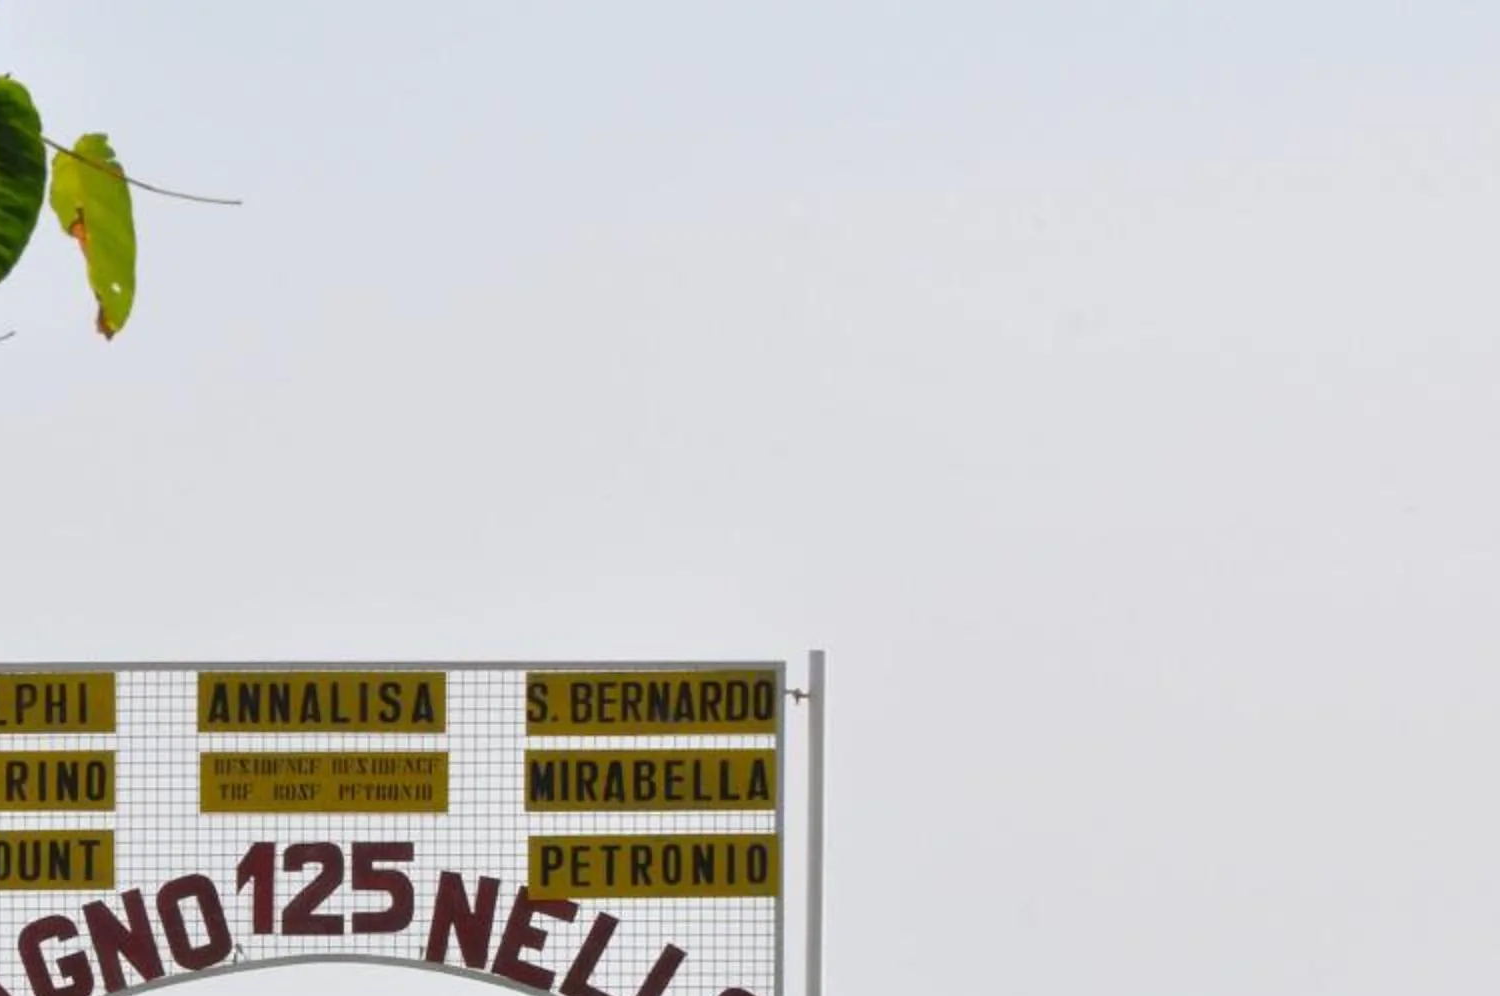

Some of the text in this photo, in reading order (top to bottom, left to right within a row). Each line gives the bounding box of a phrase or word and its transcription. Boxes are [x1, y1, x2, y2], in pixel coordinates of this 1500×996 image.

[208, 681, 435, 724] ANNALISA
[527, 679, 775, 724] S. BERNARDO
[214, 757, 440, 776] RESIDENCE RESIDENCE
[530, 758, 770, 802] MIRABELLA
[339, 782, 433, 801] PETRONIO
[541, 844, 769, 887] PETRONIO
[236, 841, 415, 936] 125
